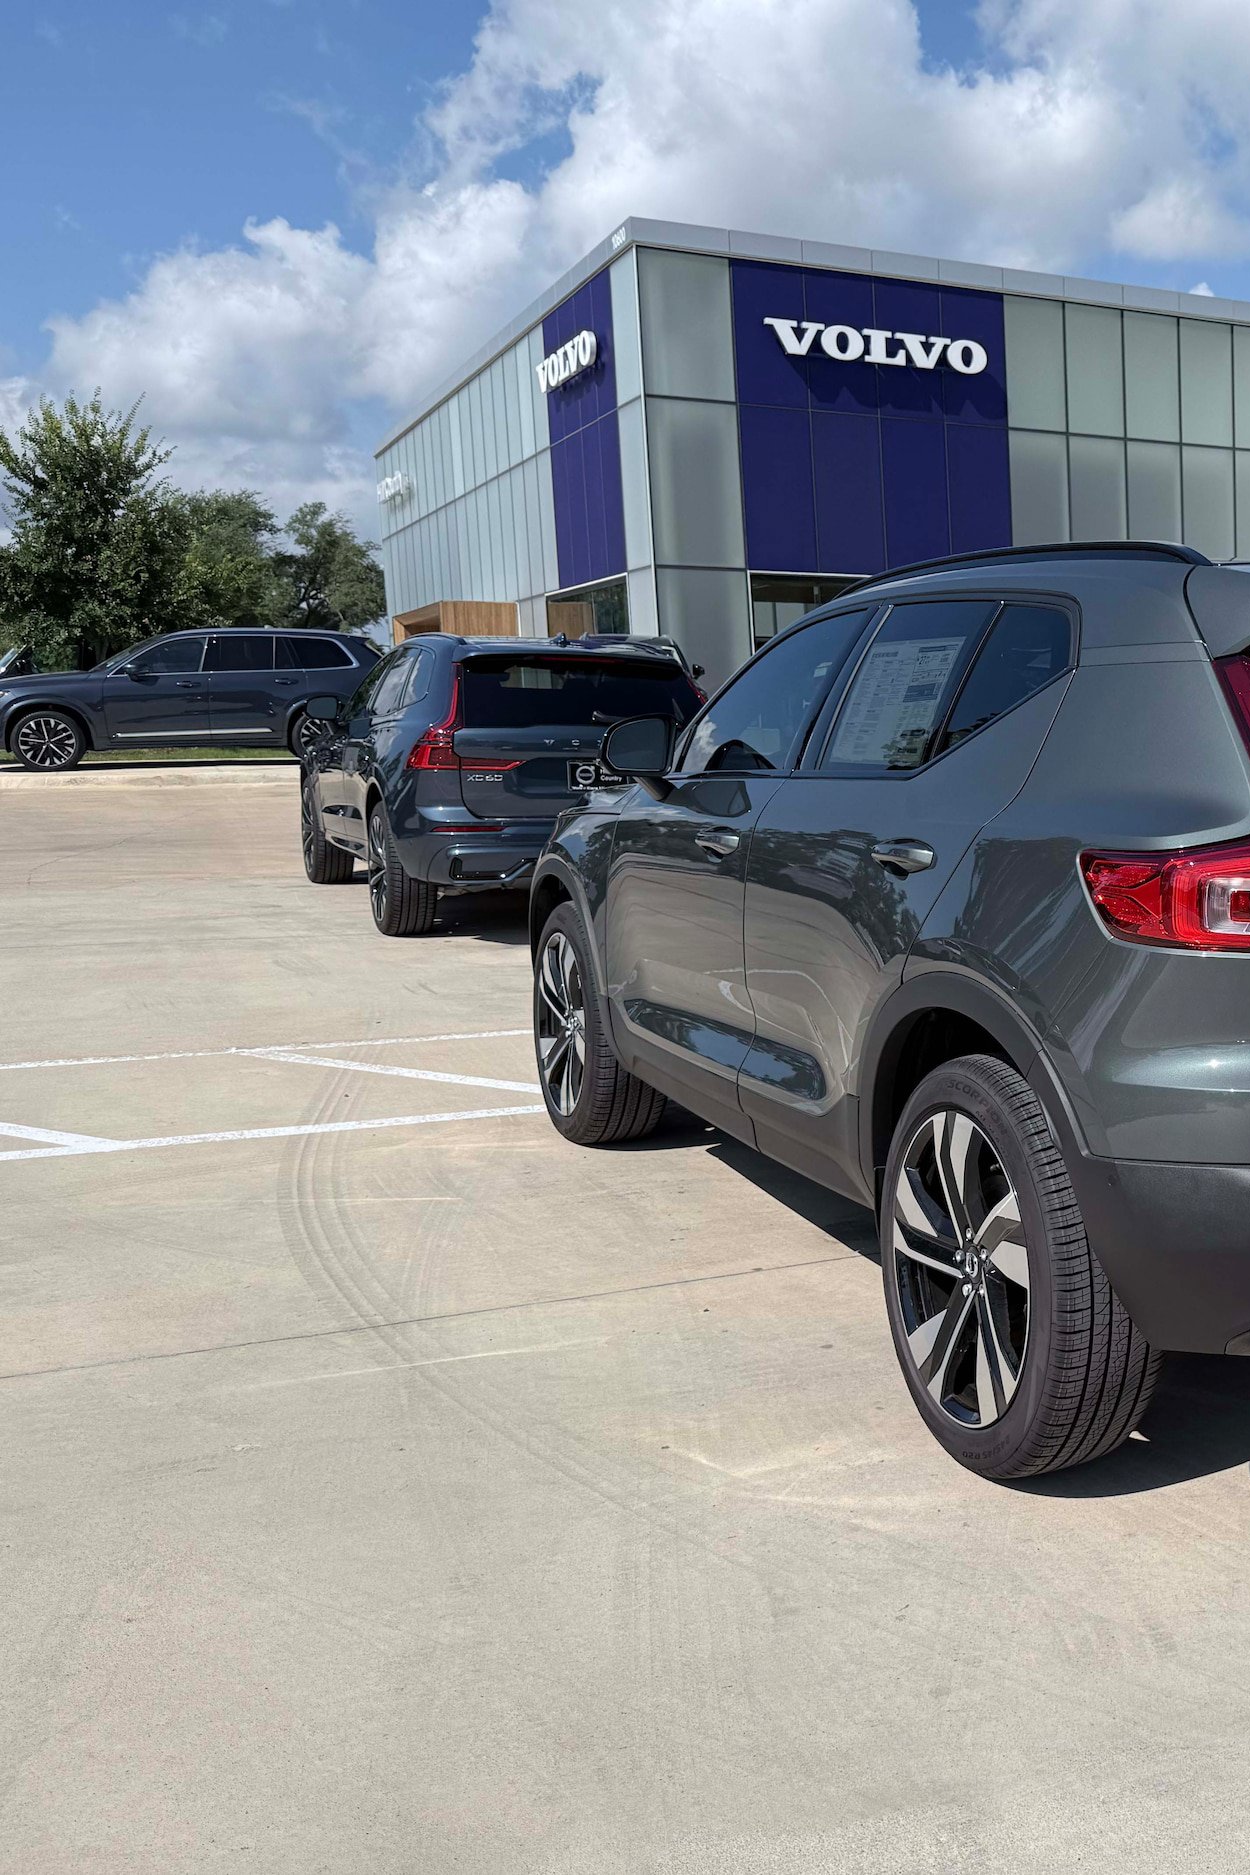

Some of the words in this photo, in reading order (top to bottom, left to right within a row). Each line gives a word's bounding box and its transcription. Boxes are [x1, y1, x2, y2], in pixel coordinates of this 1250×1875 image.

[535, 330, 597, 393] VOLVO
[763, 317, 988, 375] VOLVO
[467, 774, 503, 782] XC60
